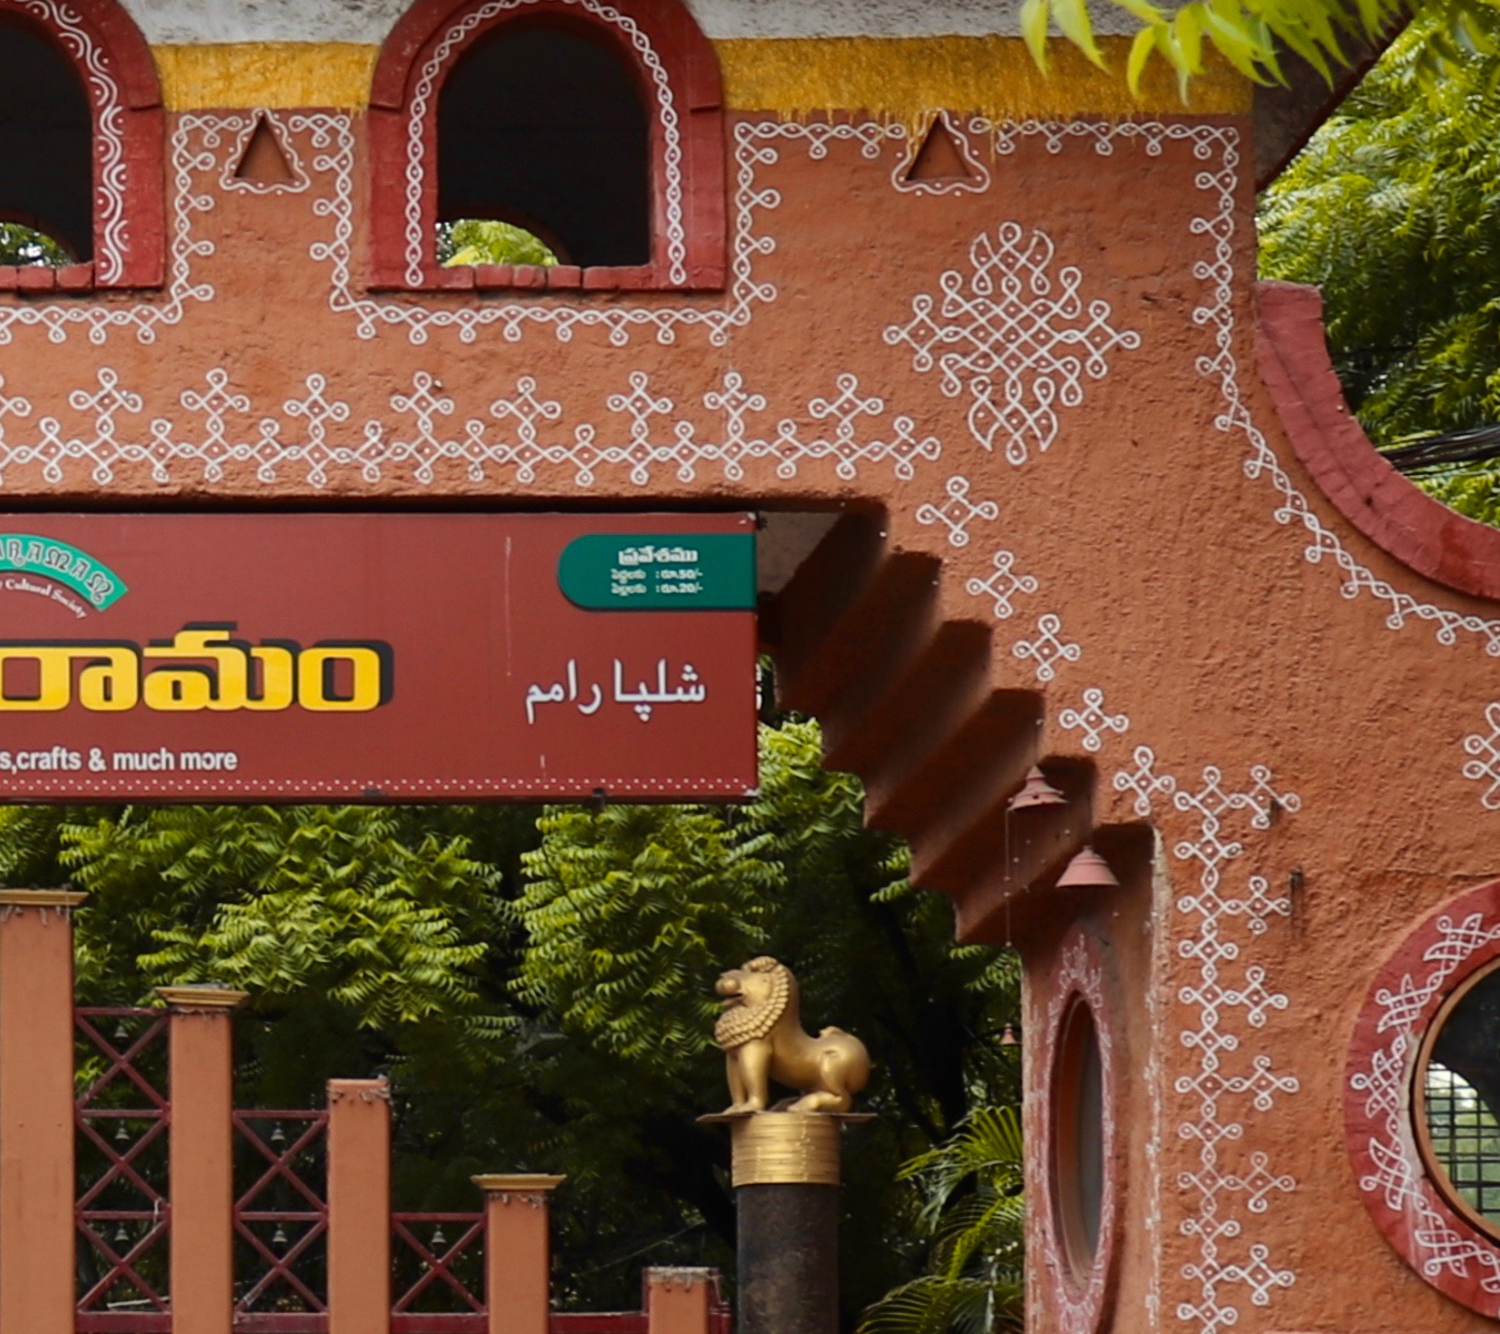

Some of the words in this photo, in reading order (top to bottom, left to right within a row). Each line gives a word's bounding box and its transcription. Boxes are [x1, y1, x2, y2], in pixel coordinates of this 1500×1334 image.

[5, 578, 53, 597] Cultural
[52, 589, 88, 620] Society
[88, 748, 107, 772] &
[113, 747, 175, 771] much
[180, 751, 238, 771] more
